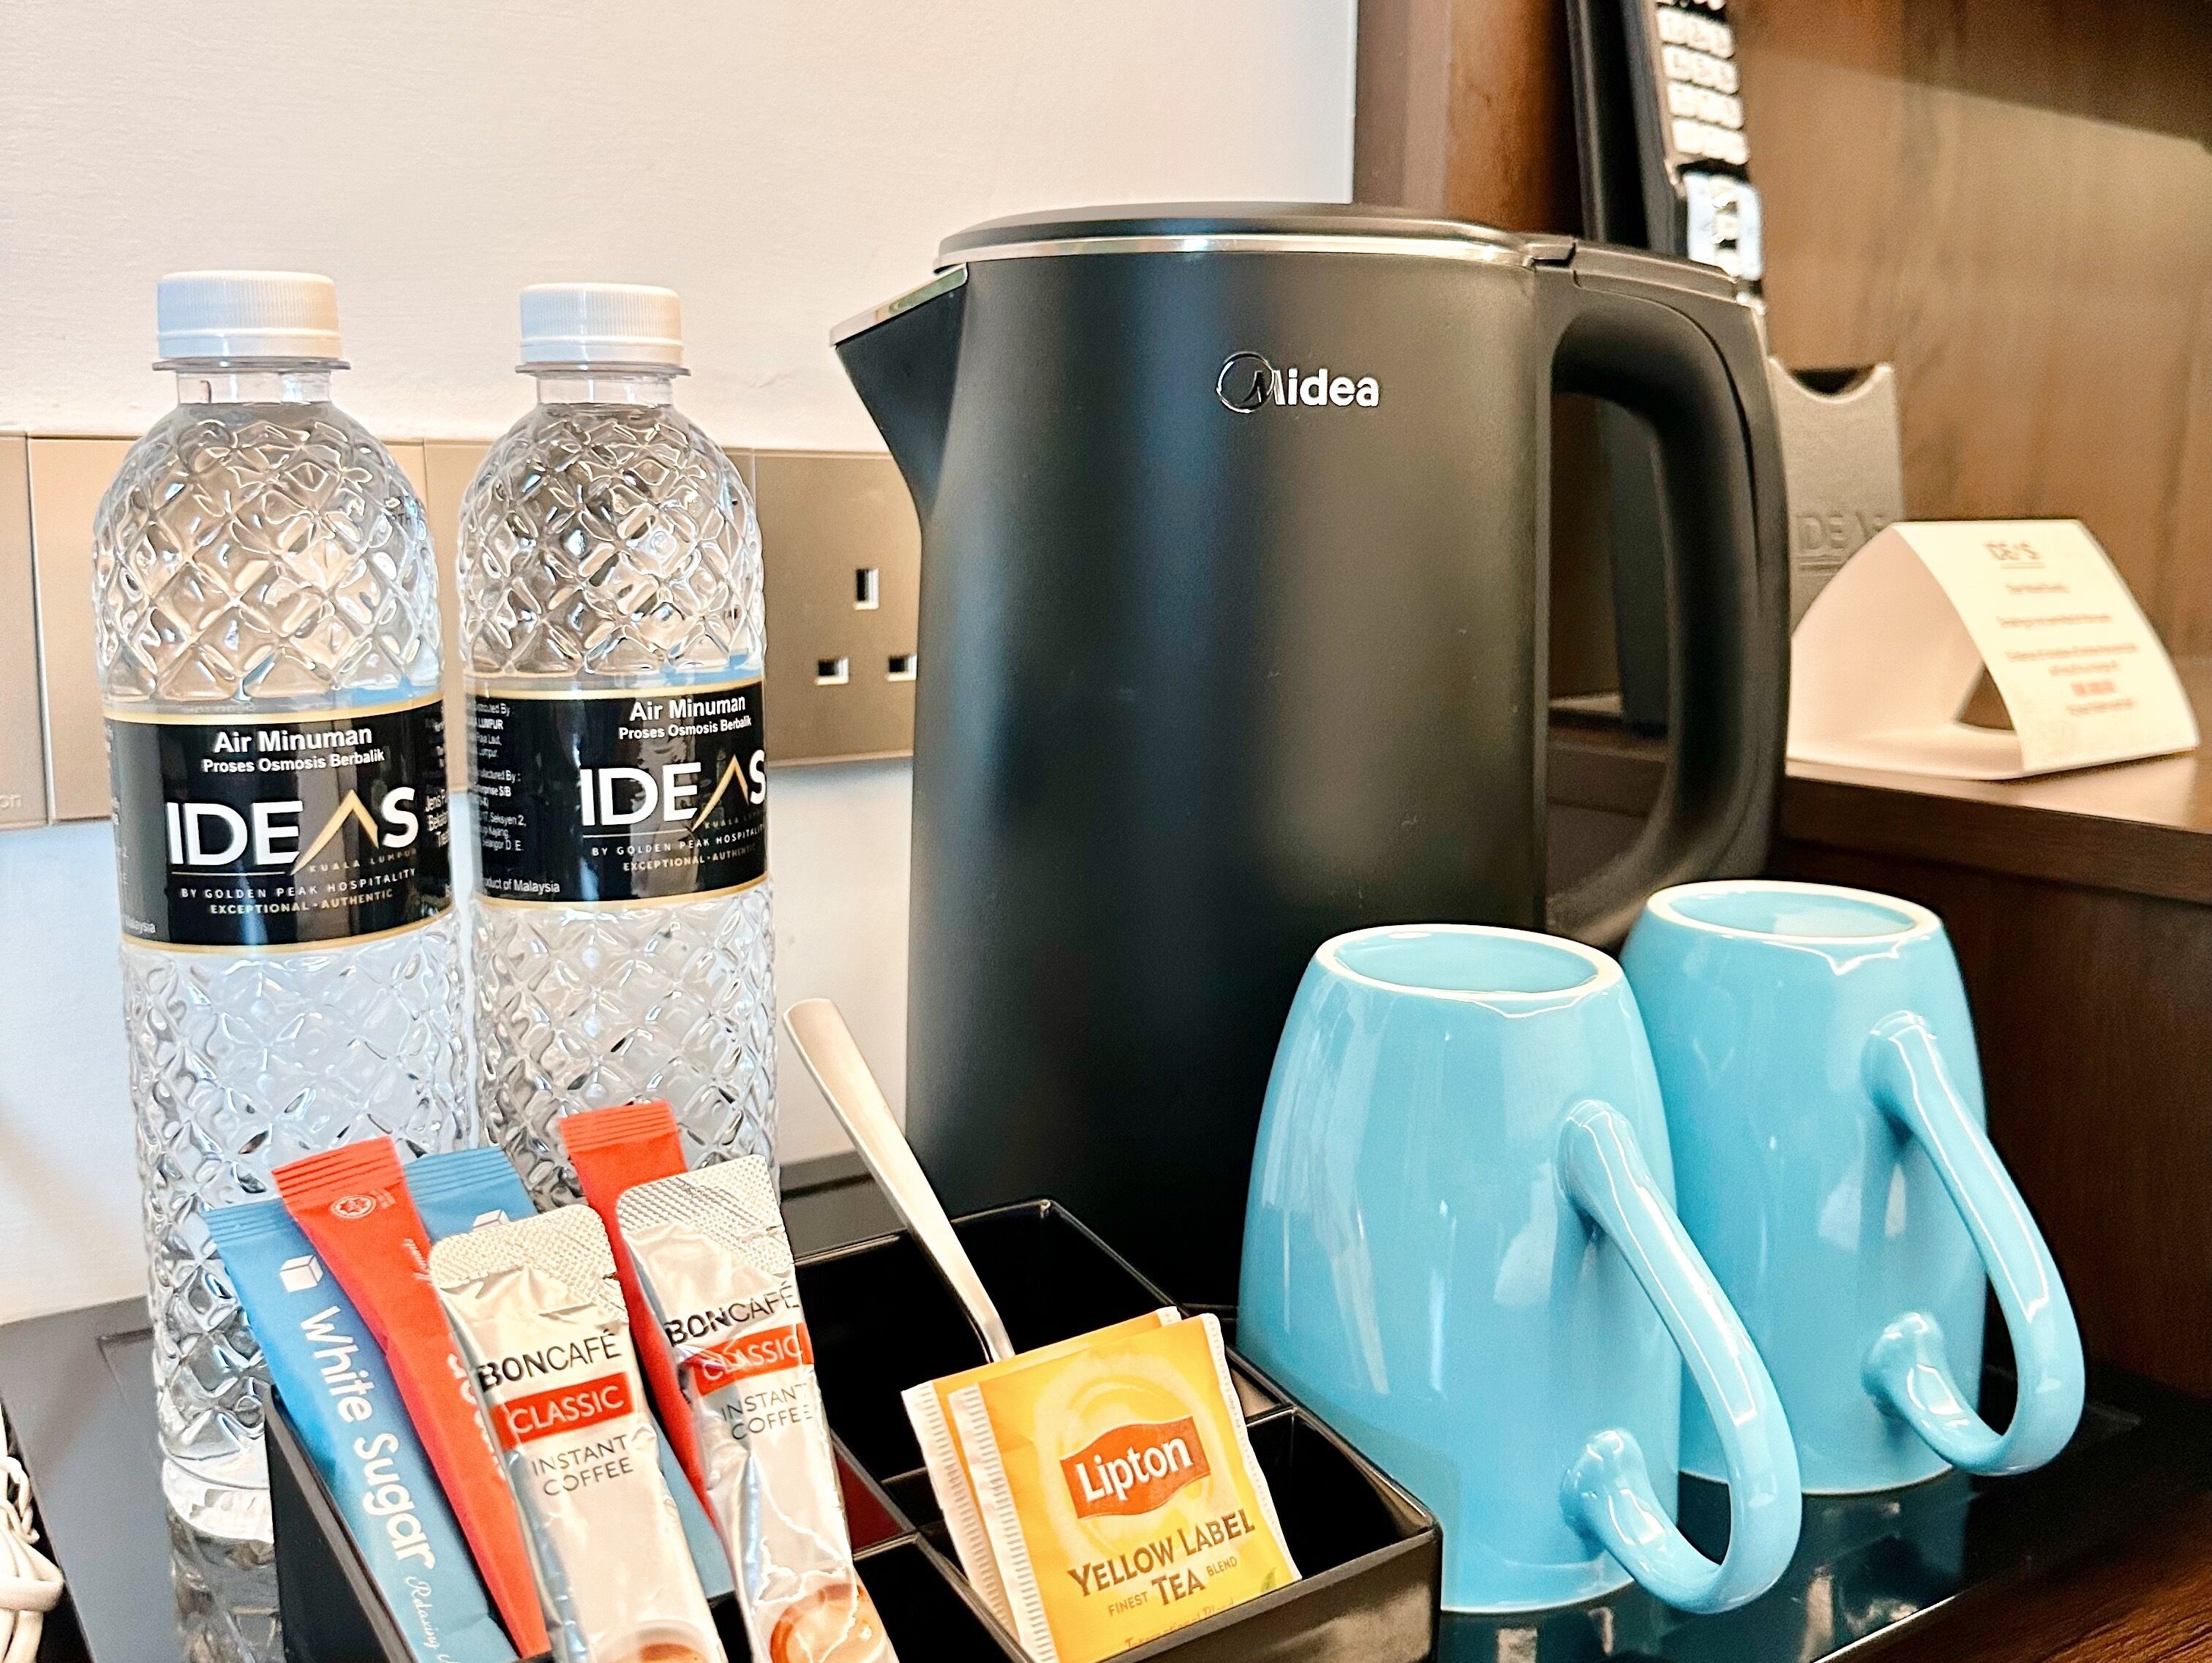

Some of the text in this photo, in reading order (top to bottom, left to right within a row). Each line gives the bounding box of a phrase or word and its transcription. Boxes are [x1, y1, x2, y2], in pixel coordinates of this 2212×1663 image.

[1220, 357, 1380, 412] Midea
[619, 715, 752, 740] Proses Osmosis Berbalik
[630, 696, 746, 721] Air Minuman
[214, 727, 373, 754] Air Minuman
[202, 749, 385, 774] Proses Osmosis Berbalik
[309, 848, 418, 874] KUALA LUMPUR
[592, 846, 609, 856] BY
[617, 842, 672, 855] GOLDEN
[680, 840, 710, 849] PEAK
[181, 868, 416, 900] BY GOLDEN PEAK HOSPITALITY
[503, 878, 512, 890] of
[514, 879, 560, 895] Malaysia
[664, 1280, 800, 1347] BONCAFÉ
[477, 1328, 622, 1392] BONCAFÉ
[701, 1335, 802, 1381] CLASSIC
[511, 1386, 624, 1433] CLASSIC
[721, 1382, 808, 1422] INSTANT
[731, 1404, 813, 1440] COFFEE
[300, 1305, 436, 1570] White Sugar
[531, 1434, 628, 1477] INSTANT
[543, 1457, 634, 1496] COFFEE
[1075, 1437, 1195, 1503] Lipton
[1066, 1508, 1256, 1597] YELLOW LABEL
[1151, 1555, 1238, 1606] TEA BLEND
[405, 1576, 440, 1650] Relaxing
[1107, 1591, 1149, 1618] FINEST
